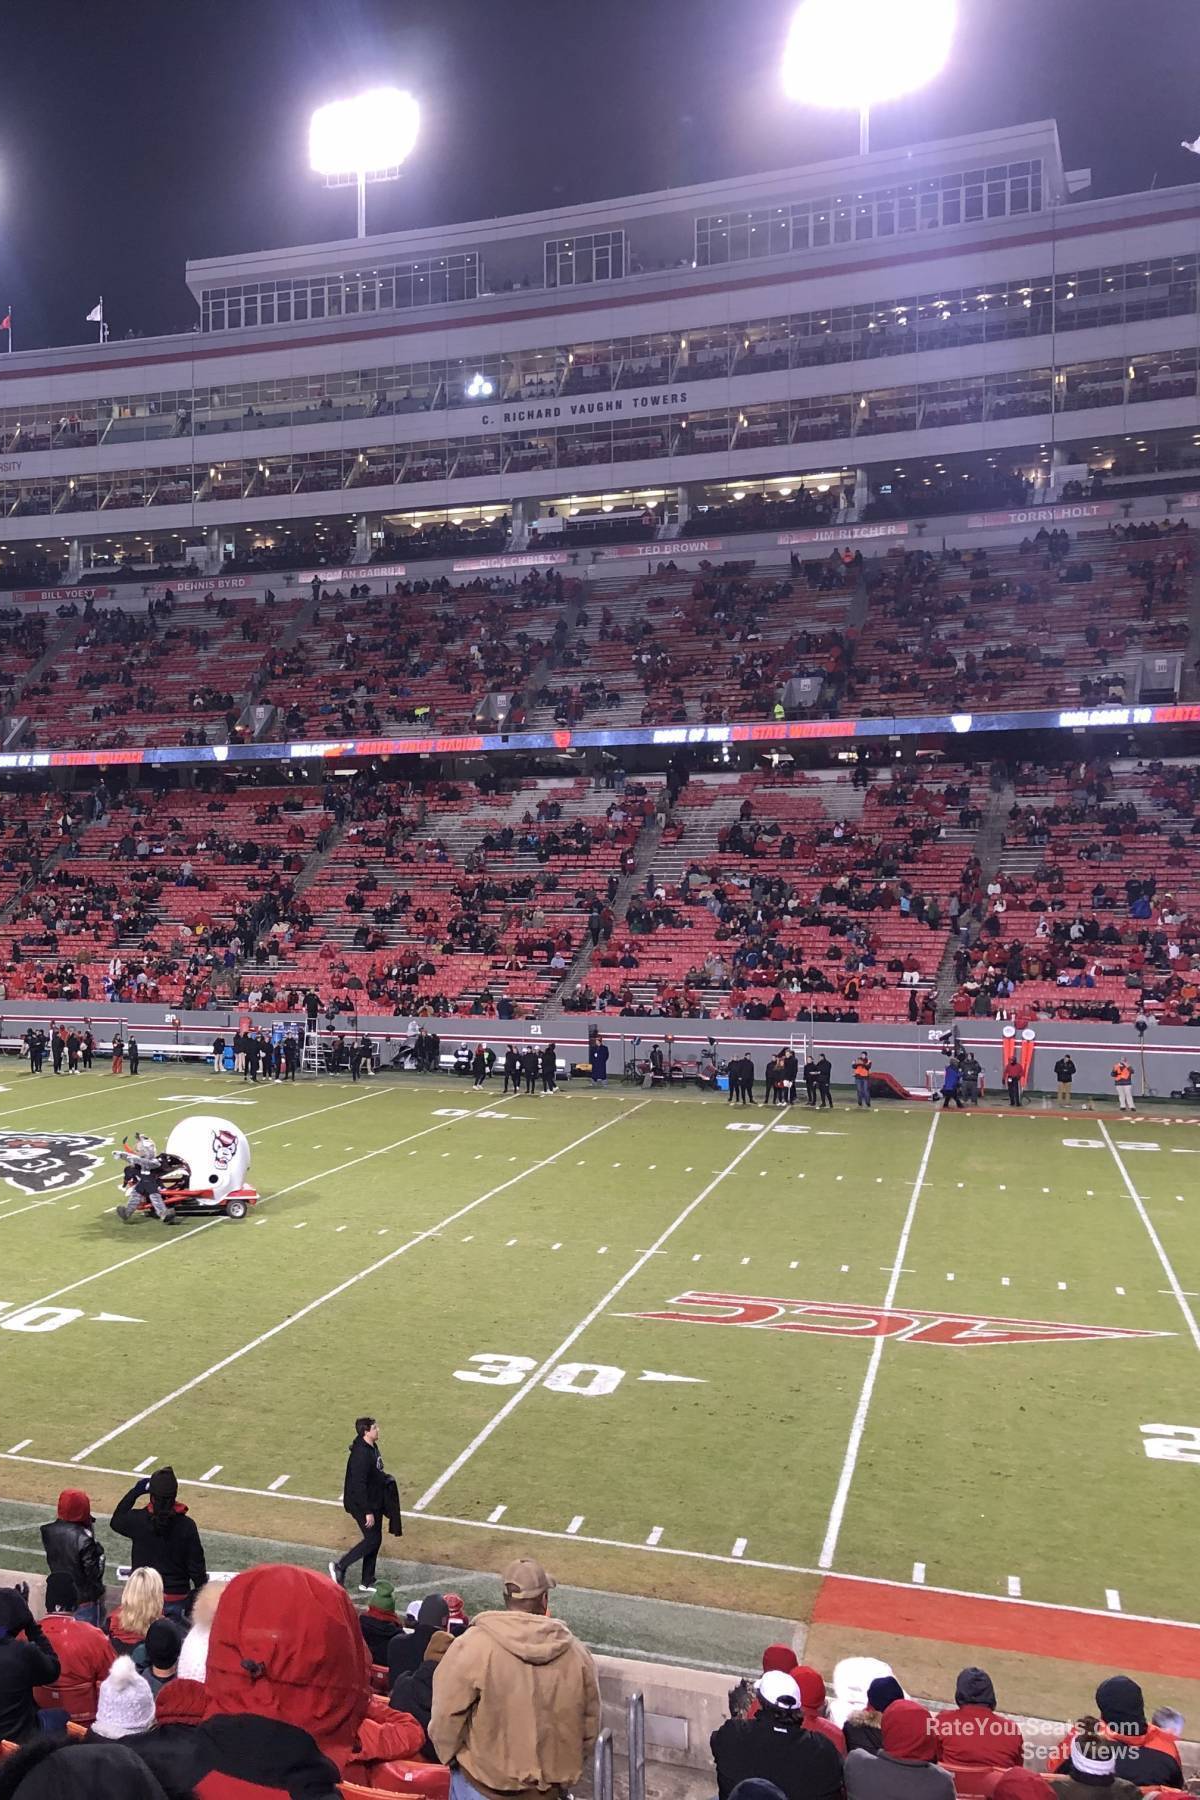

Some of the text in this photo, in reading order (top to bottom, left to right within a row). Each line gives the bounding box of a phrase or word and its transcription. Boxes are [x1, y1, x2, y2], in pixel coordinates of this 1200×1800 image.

[481, 392, 688, 425] C. RICHARD VAUGHN TOWERS
[1008, 505, 1101, 523] TORRY HOLT
[811, 525, 897, 541] JIM RITCHER
[637, 541, 710, 555] TED BROWN
[511, 552, 561, 567] CHRISTY
[177, 578, 246, 592] DENNIS BYRD
[40, 591, 63, 600] BILL
[530, 1025, 542, 1035] 21
[431, 1107, 510, 1120] 40
[725, 1121, 812, 1134] 30
[1061, 1137, 1162, 1152] 20
[451, 1353, 626, 1397] 30
